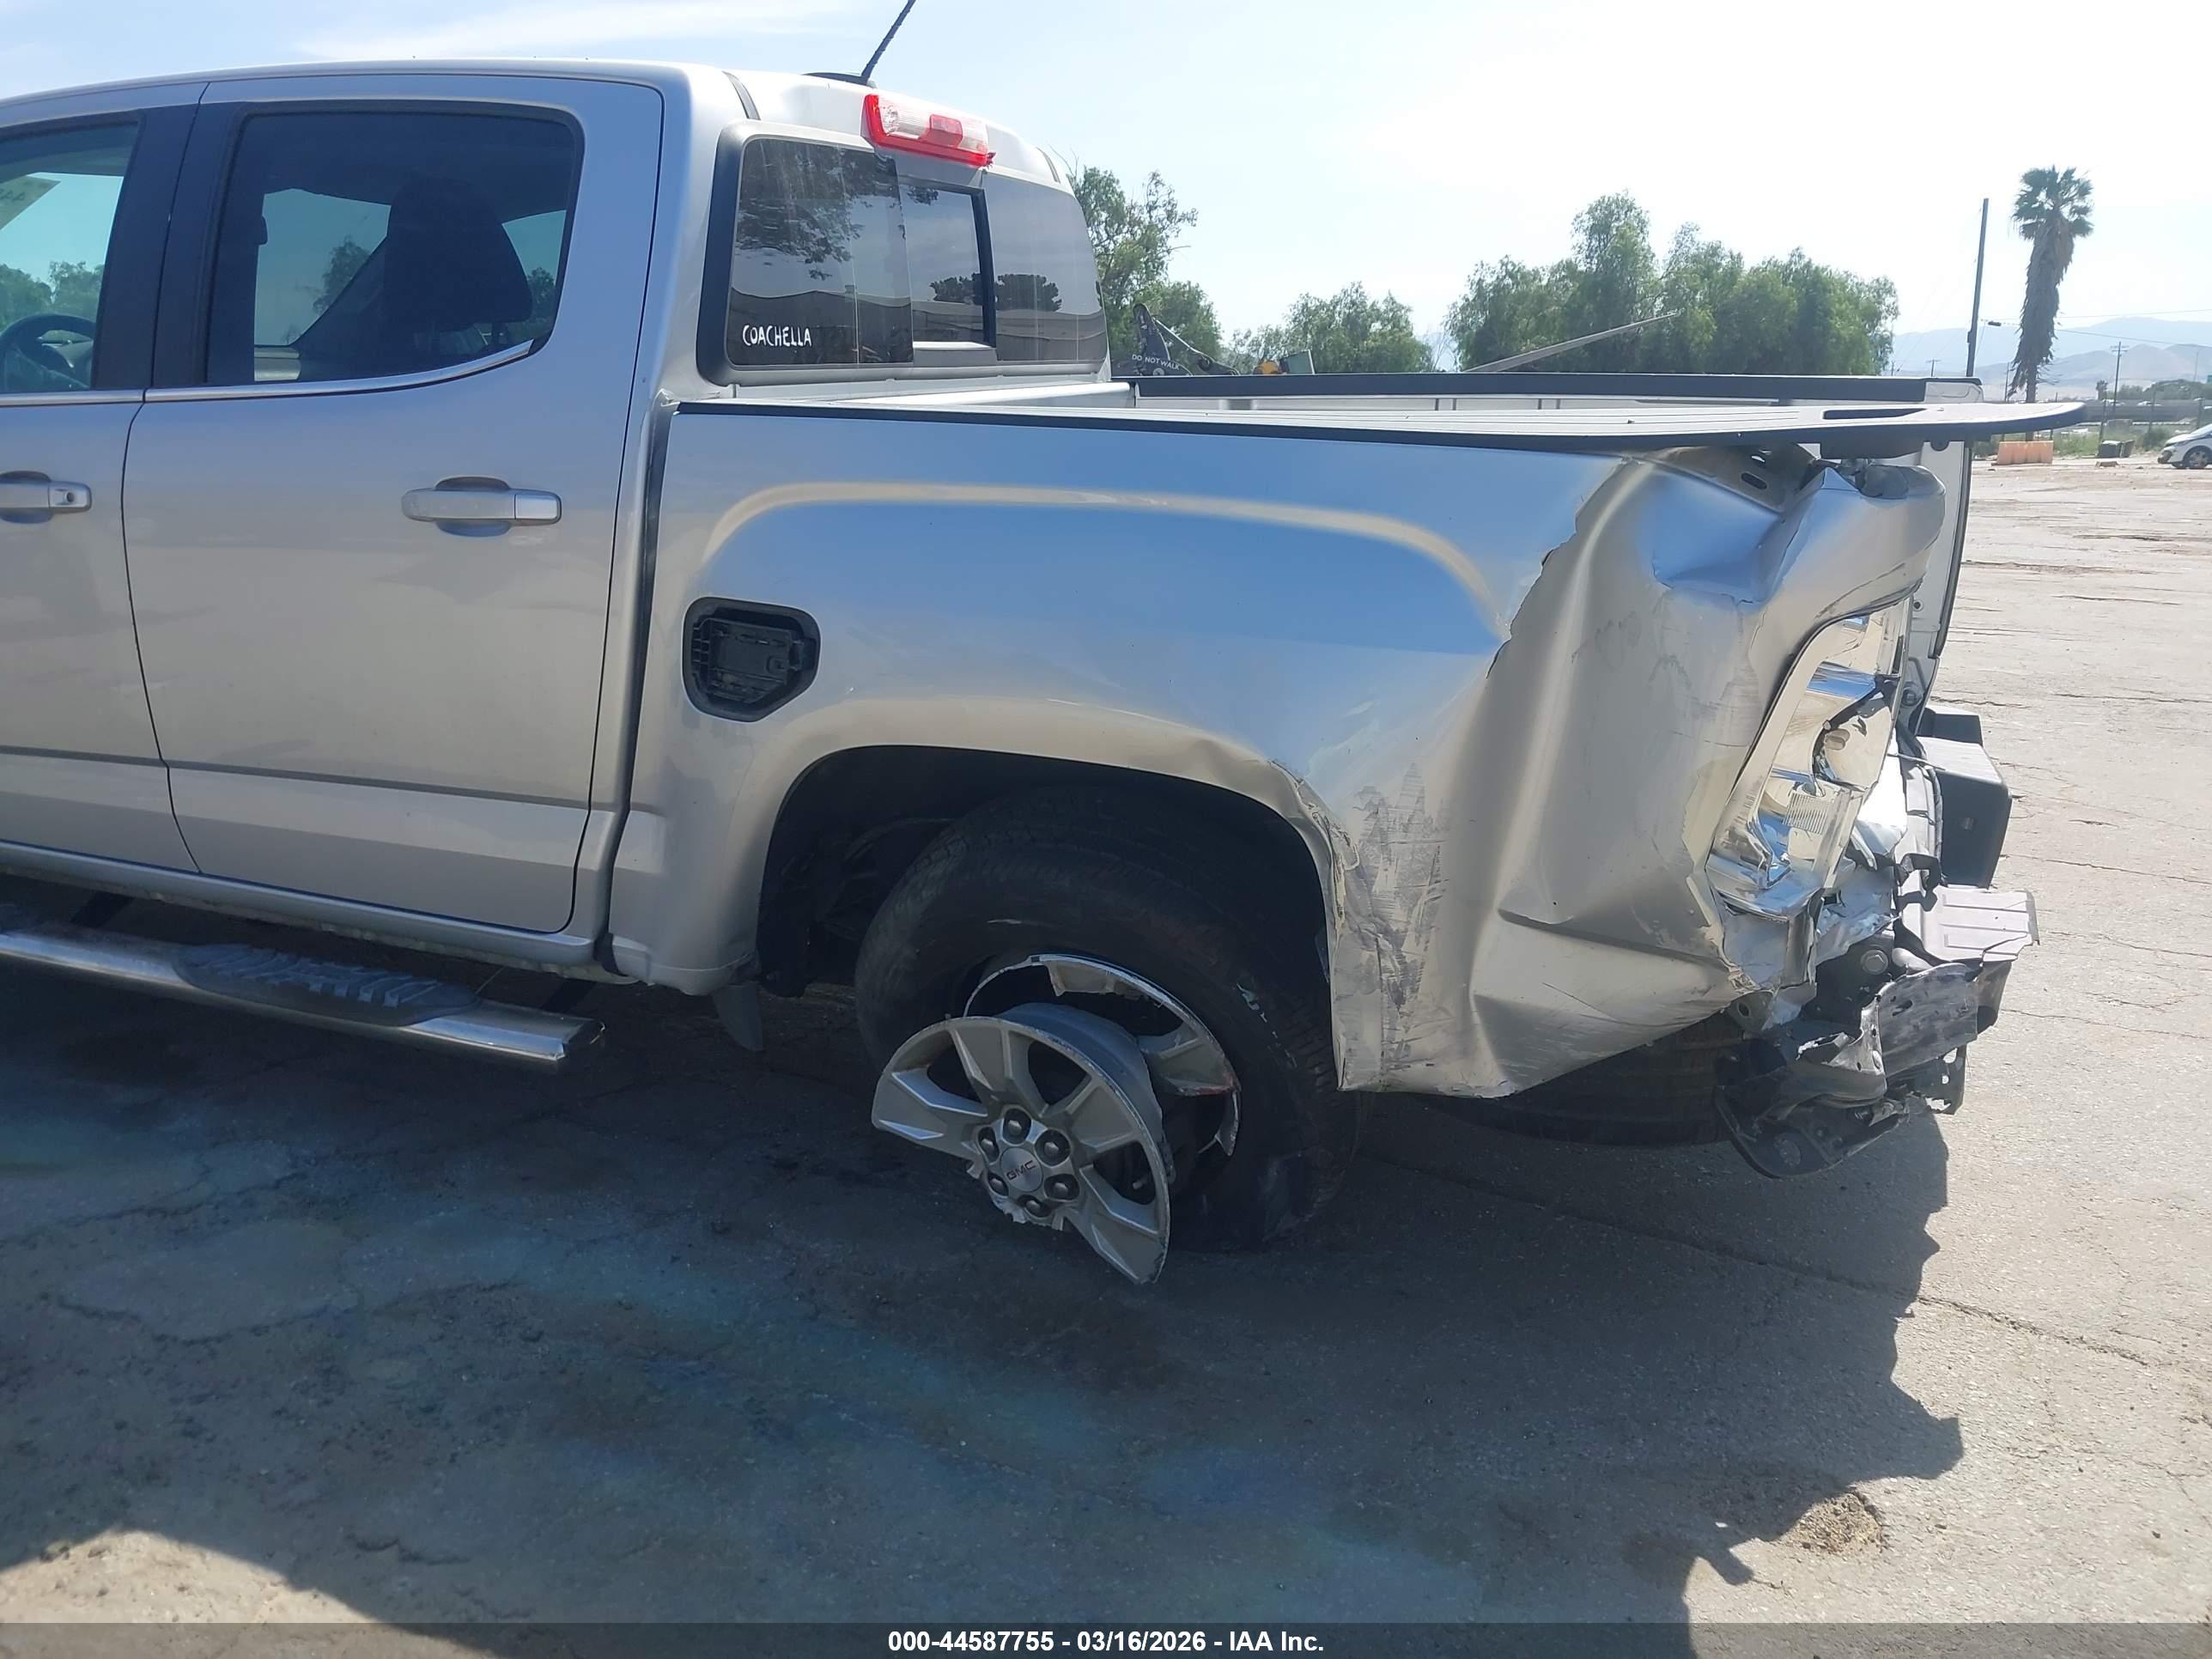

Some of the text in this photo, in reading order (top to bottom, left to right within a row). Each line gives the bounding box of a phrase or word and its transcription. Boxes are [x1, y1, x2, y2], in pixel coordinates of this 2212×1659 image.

[742, 325, 811, 347] COACHELLA
[1158, 360, 1180, 371] WALK
[1006, 1159, 1036, 1181] GMC
